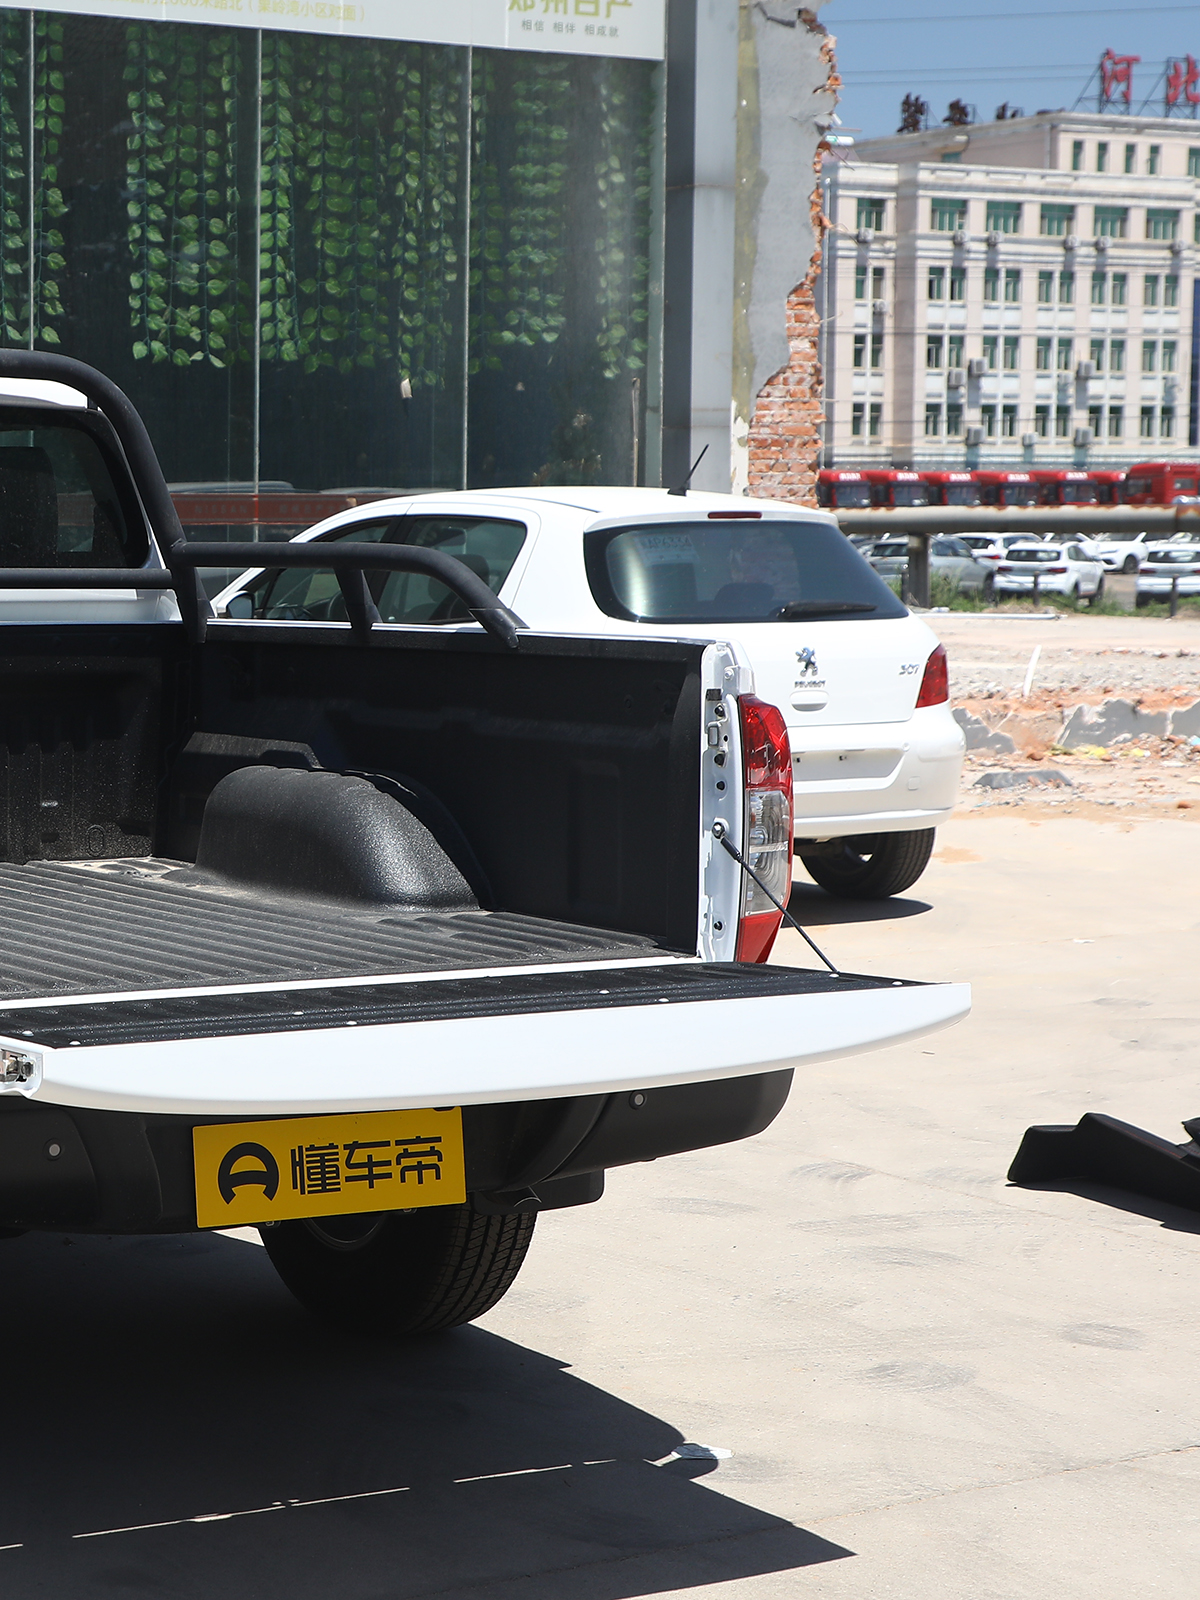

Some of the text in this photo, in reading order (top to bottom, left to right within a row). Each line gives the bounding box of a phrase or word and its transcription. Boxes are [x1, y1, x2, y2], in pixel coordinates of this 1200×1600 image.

[521, 19, 545, 32] 相信
[553, 21, 576, 34] 相伴
[290, 1135, 443, 1195] 懂车帝
